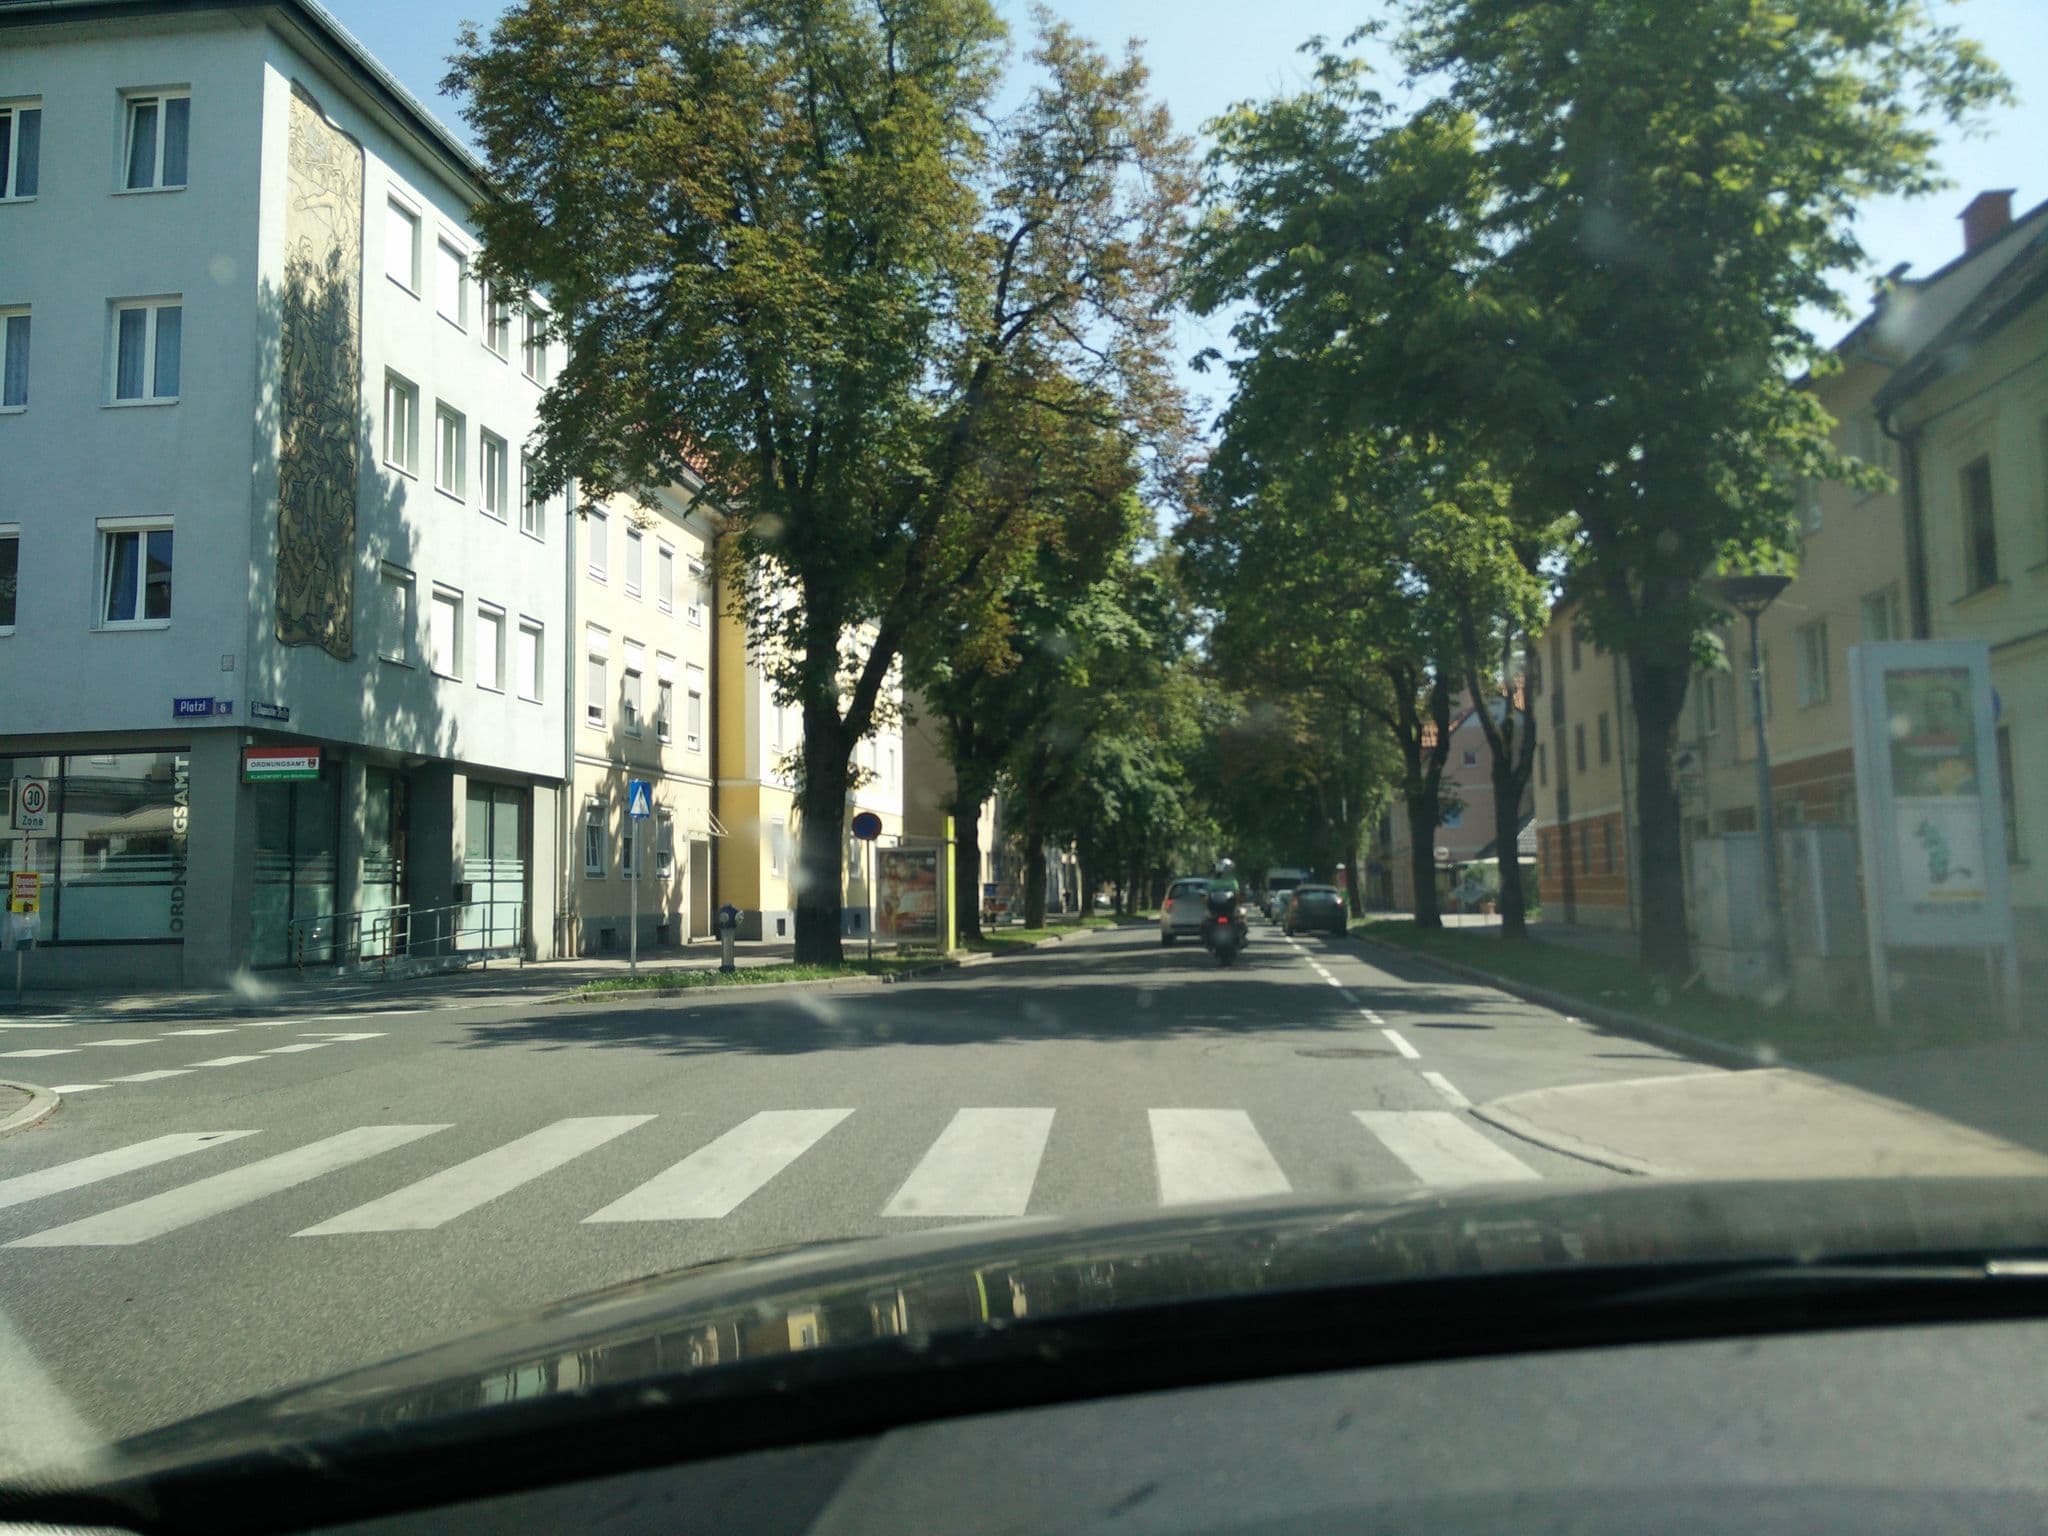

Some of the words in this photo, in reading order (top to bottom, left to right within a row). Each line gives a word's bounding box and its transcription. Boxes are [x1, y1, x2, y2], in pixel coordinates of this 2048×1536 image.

[180, 700, 206, 713] Platzl
[220, 703, 226, 713] 6
[250, 760, 306, 768] ORDNUNGSAMT
[27, 791, 40, 806] 30
[22, 815, 44, 826] Zone
